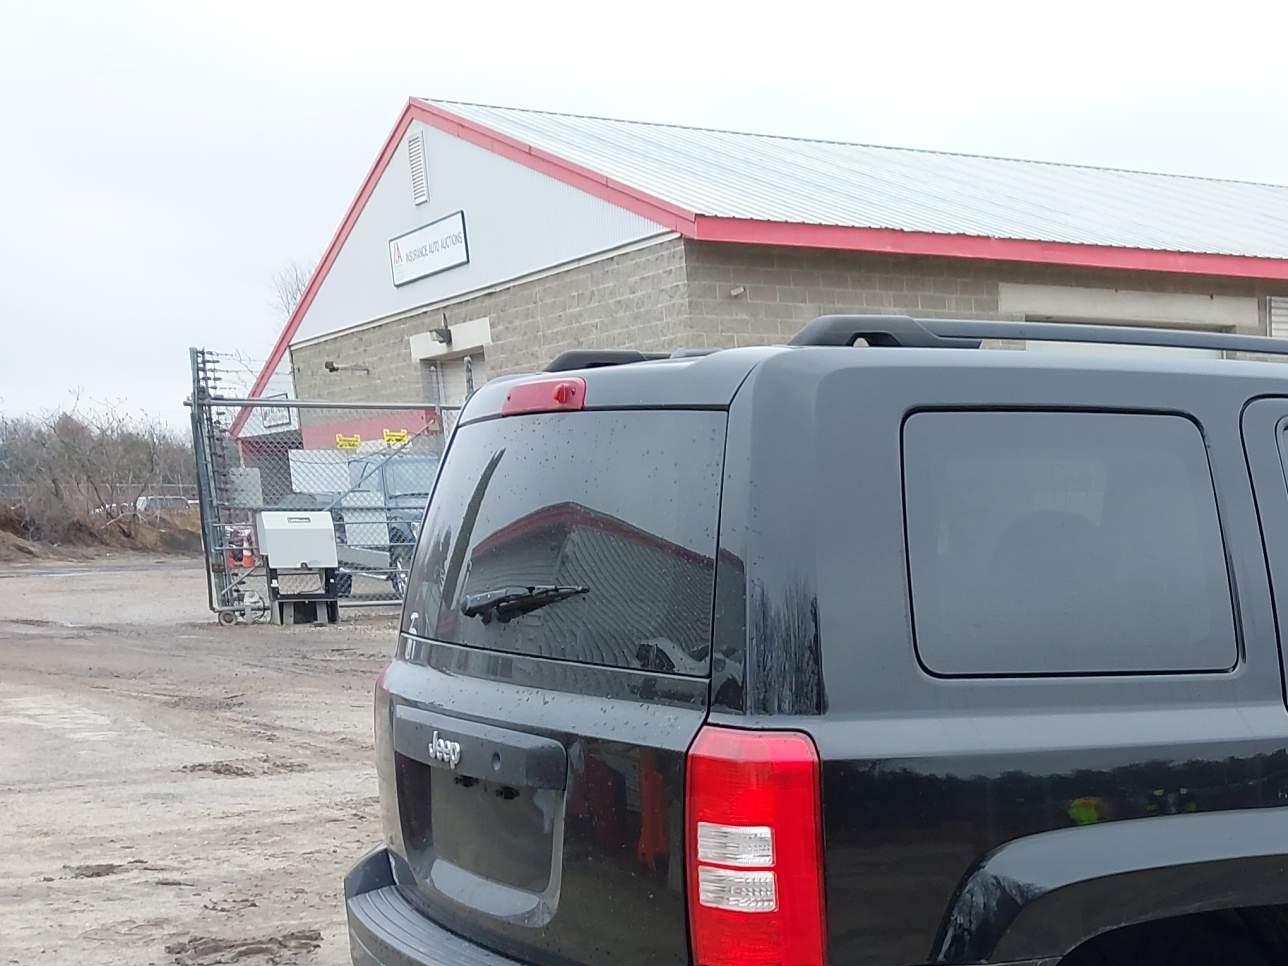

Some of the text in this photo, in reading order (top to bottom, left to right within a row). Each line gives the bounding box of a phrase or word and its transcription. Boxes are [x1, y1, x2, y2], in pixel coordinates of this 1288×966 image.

[429, 240, 440, 254] AUTO
[441, 231, 463, 249] AUCTIONS
[428, 730, 461, 769] Jeep
